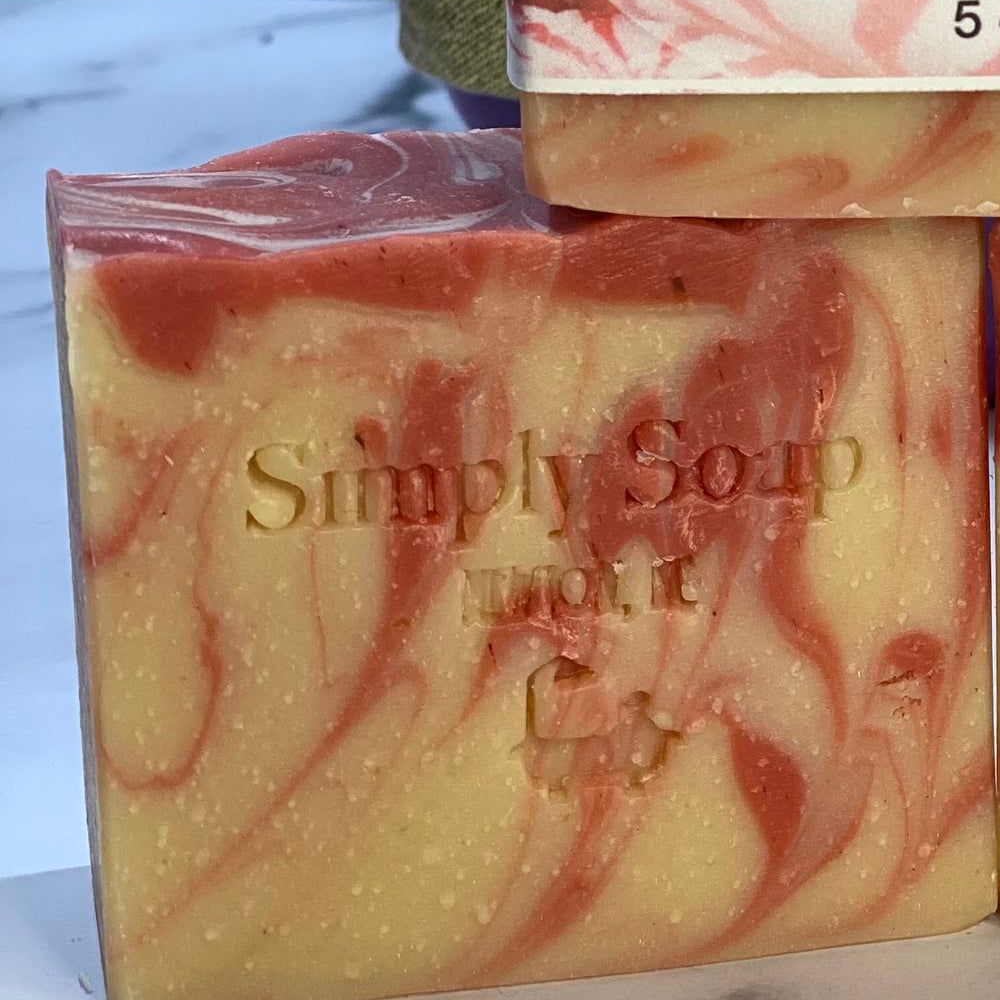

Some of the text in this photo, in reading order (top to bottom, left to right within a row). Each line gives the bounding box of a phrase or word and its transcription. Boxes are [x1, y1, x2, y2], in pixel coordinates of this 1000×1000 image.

[954, 0, 982, 39] 5
[244, 418, 865, 550] Simply Soap
